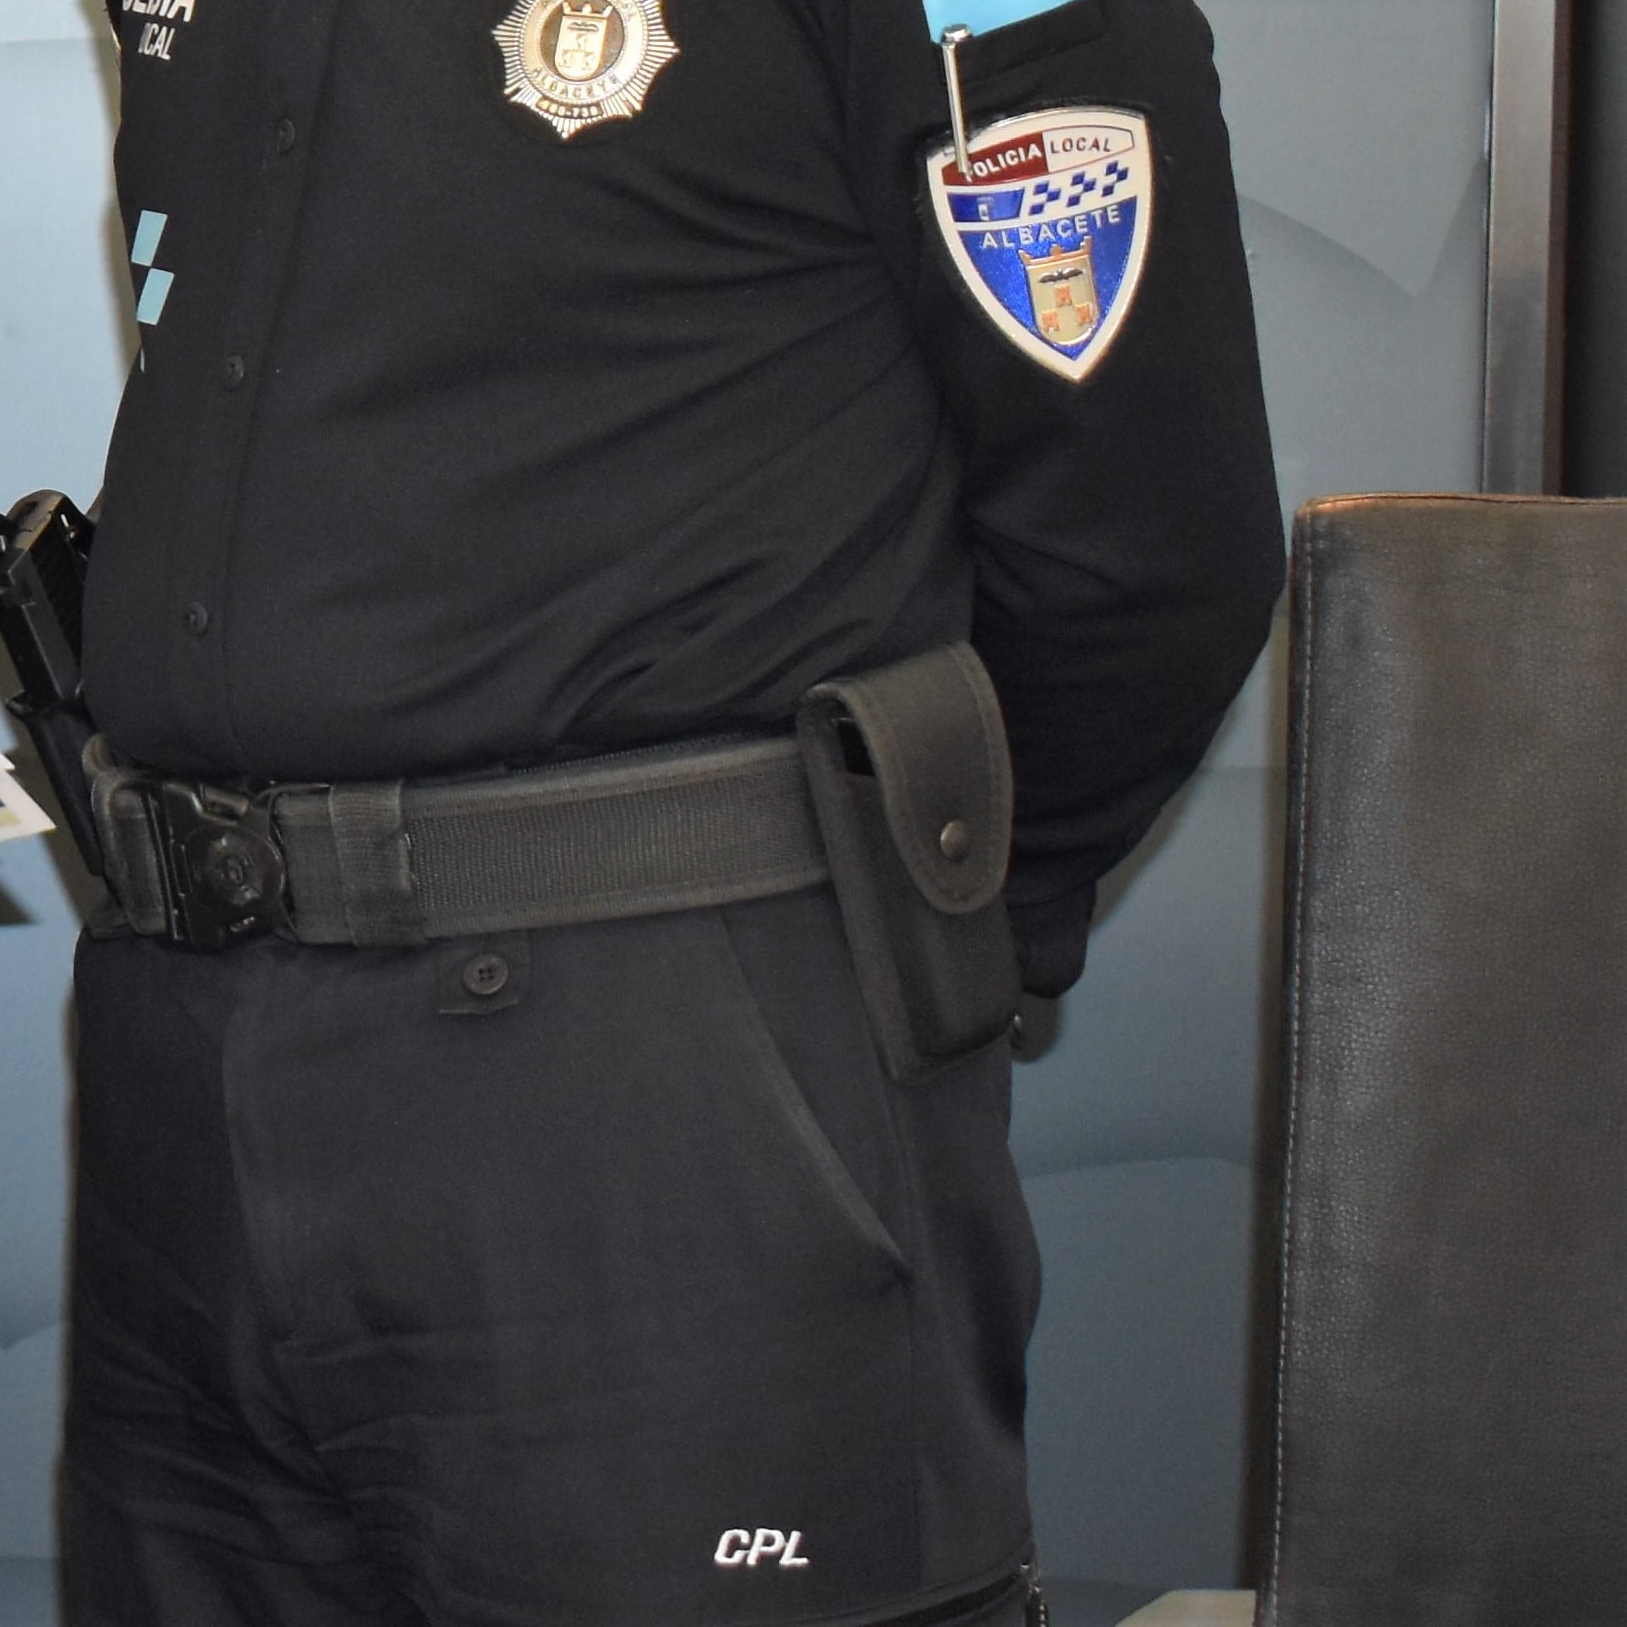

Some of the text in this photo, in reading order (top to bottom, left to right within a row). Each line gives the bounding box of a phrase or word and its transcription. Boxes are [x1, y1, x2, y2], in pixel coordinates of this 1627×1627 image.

[1049, 136, 1112, 155] LOCAL
[981, 204, 1122, 250] ALBACETE
[713, 1527, 811, 1567] CPL
